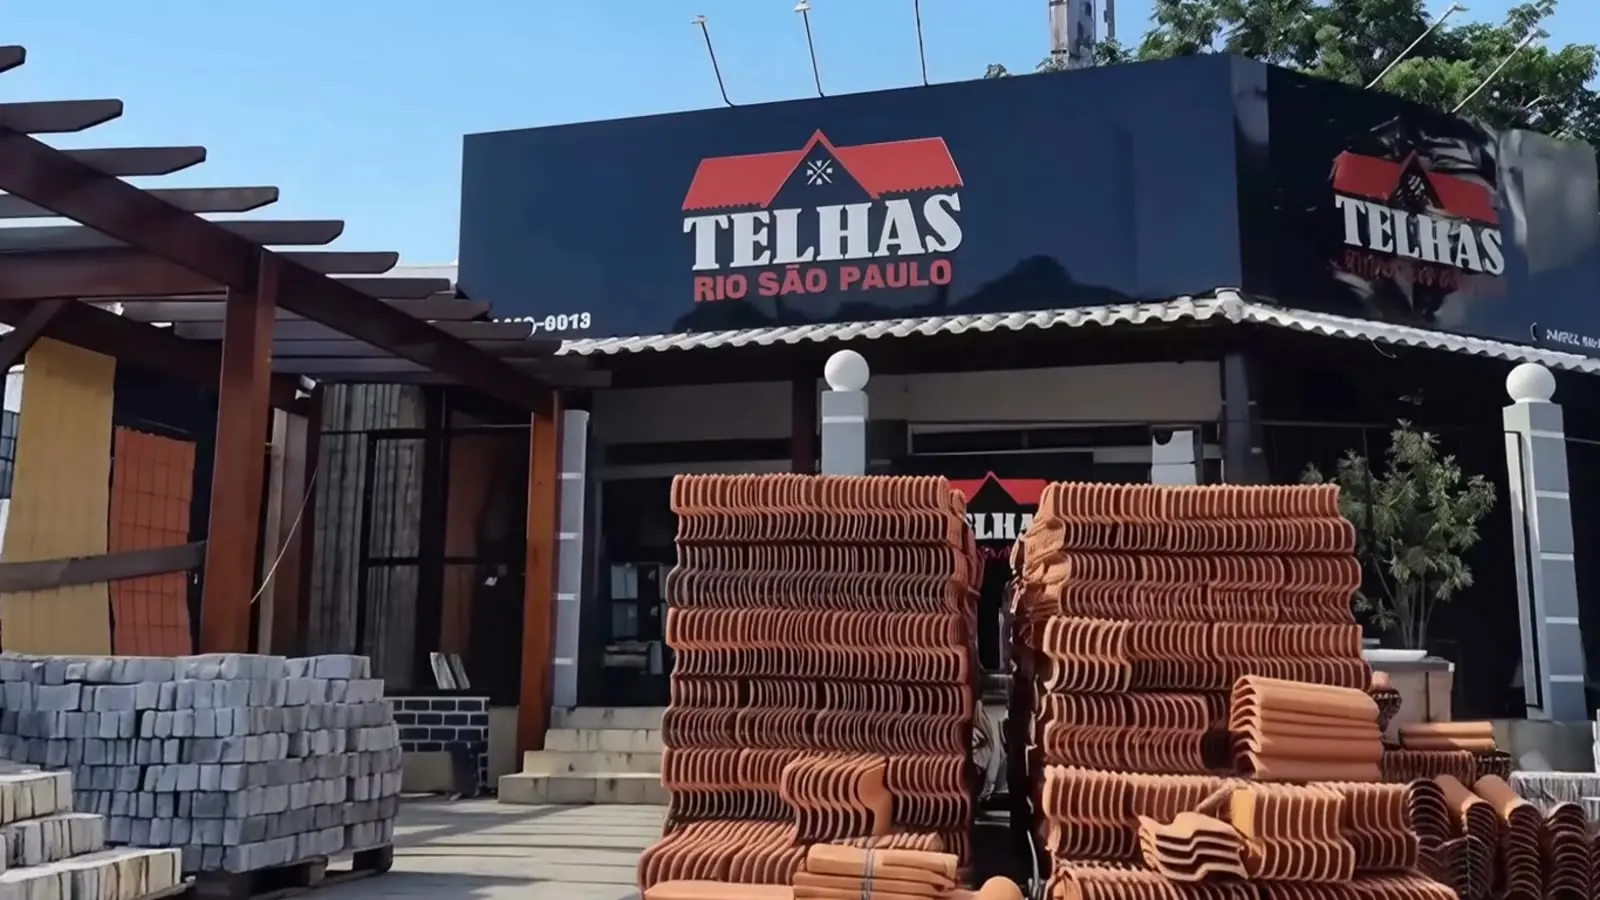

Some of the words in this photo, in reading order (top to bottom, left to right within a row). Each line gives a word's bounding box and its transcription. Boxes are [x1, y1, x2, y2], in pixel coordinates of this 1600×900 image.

[683, 192, 963, 271] TELHAS
[1335, 194, 1505, 276] TELHAS
[694, 274, 748, 302] RIO
[758, 264, 827, 296] SÃO
[840, 259, 952, 291] PAULO
